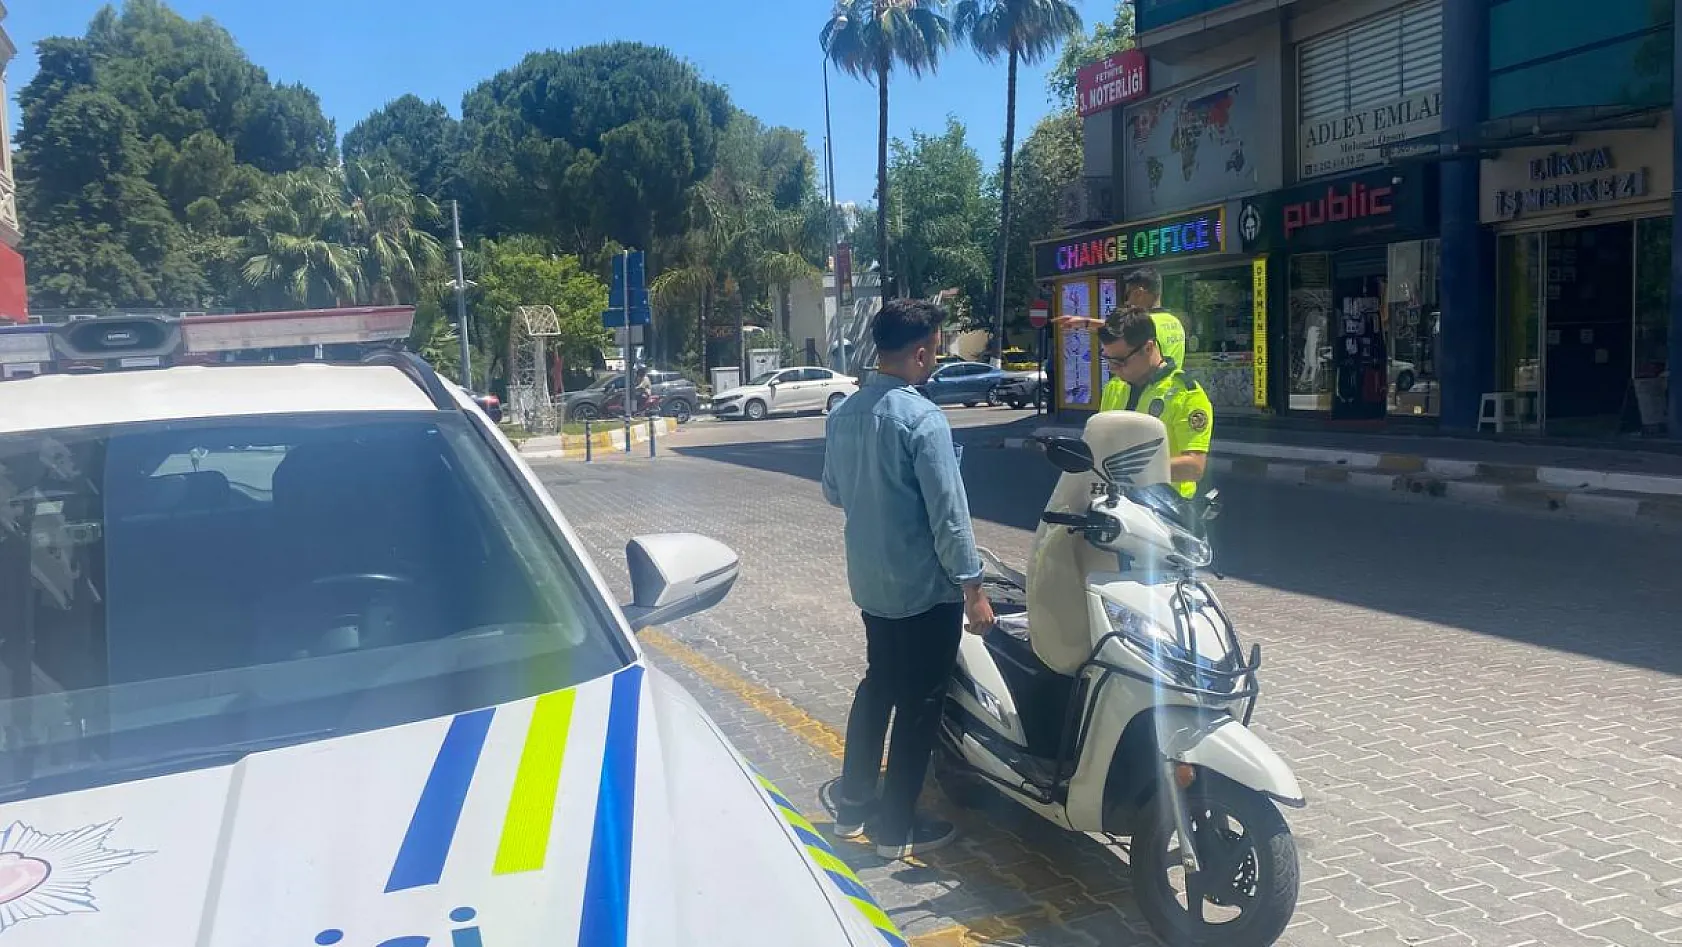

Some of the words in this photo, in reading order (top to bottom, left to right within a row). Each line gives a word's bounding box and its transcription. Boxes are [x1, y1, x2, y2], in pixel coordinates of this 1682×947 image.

[1089, 65, 1143, 110] NOTERLİĞİ
[1306, 112, 1367, 148] ADLEY
[1283, 182, 1392, 240] public
[1056, 233, 1128, 270] CHANGE
[1133, 216, 1210, 258] OFFICE
